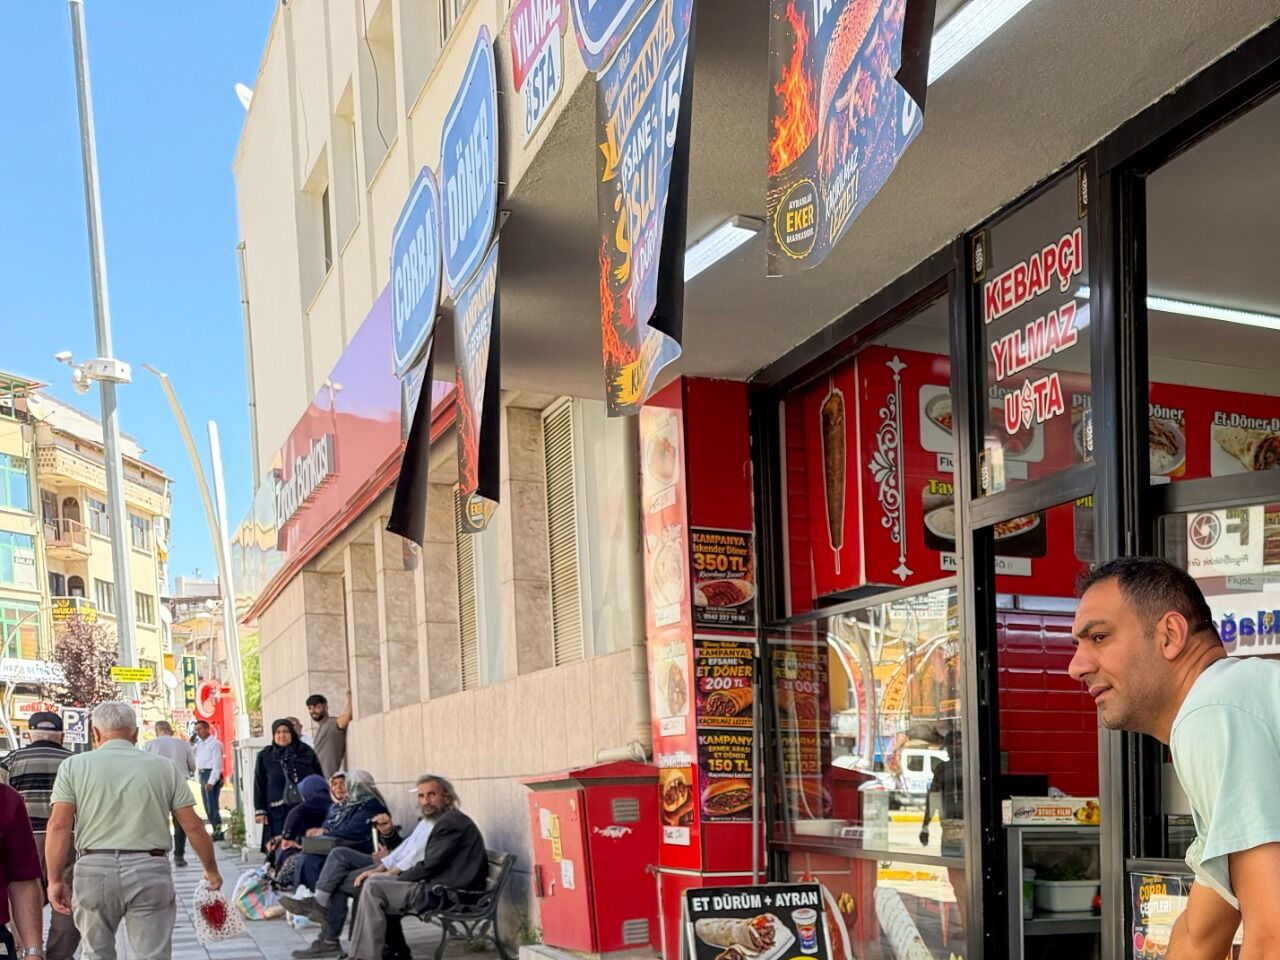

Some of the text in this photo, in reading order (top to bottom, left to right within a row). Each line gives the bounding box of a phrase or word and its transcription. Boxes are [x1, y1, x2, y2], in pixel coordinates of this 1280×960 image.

[447, 98, 490, 259] DÖNER
[786, 204, 814, 233] EKER
[395, 208, 434, 341] ÇORBA
[984, 227, 1082, 325] KEBAPÇI
[991, 300, 1077, 381] YILMAZ
[1004, 372, 1064, 435] USTA
[1214, 411, 1228, 425] Et
[1231, 413, 1268, 430] Döner
[692, 533, 745, 546] KAMPANYA
[694, 553, 748, 571] 350 TL
[697, 664, 752, 677] ET DÖNER
[706, 677, 744, 690] 200 TL
[64, 711, 79, 729] P
[699, 735, 753, 745] KAMPANY
[708, 758, 753, 772] 150 TL
[692, 897, 709, 912] ET
[714, 893, 762, 910] DÜRÜM
[775, 891, 819, 908] AYRAN
